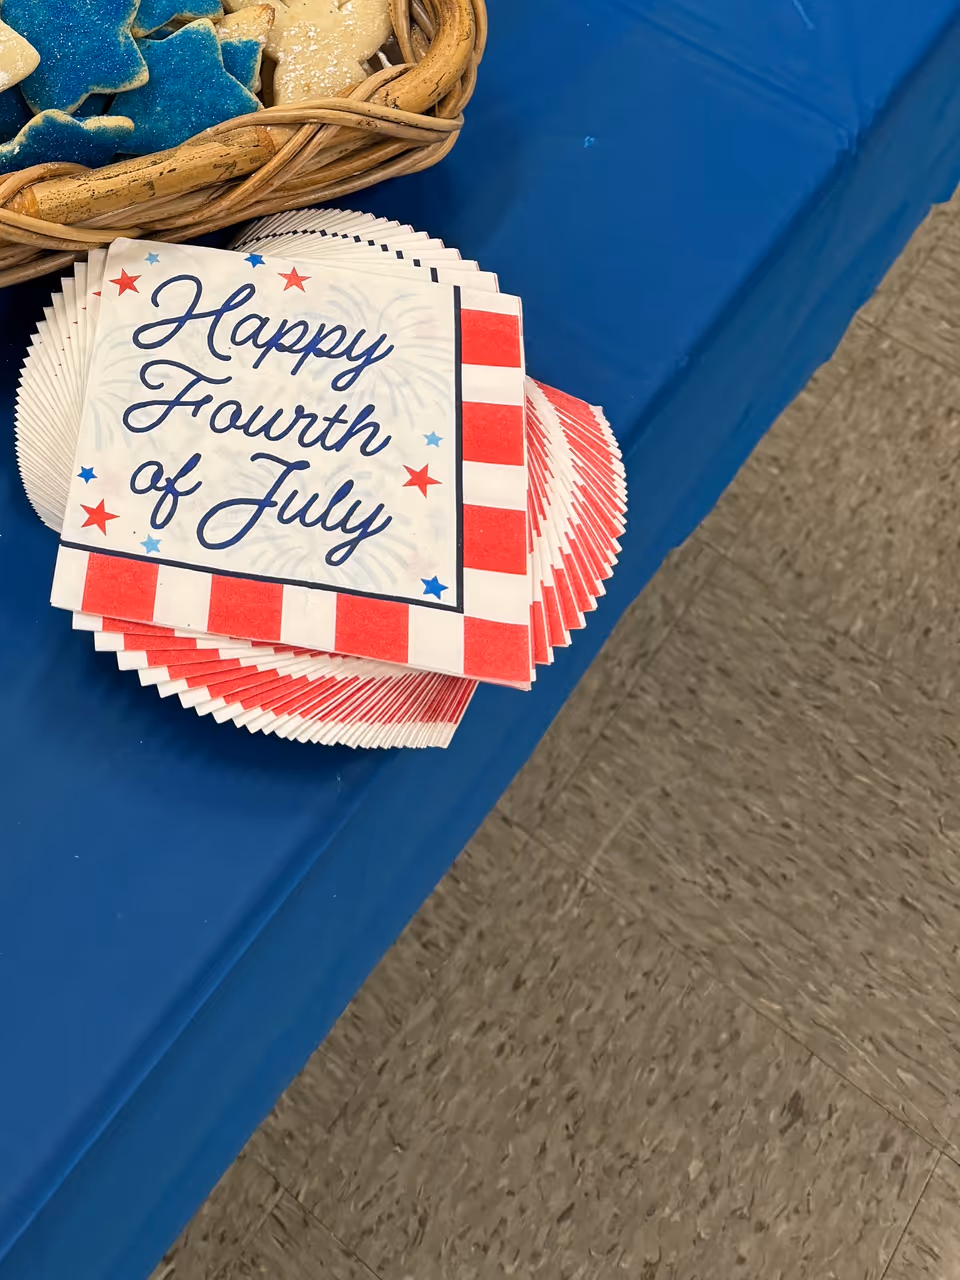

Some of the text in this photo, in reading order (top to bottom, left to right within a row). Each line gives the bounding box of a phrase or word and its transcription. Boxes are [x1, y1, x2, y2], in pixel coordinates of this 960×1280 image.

[132, 274, 395, 392] Happy
[122, 359, 392, 457] Fourth
[129, 452, 393, 567] of July
